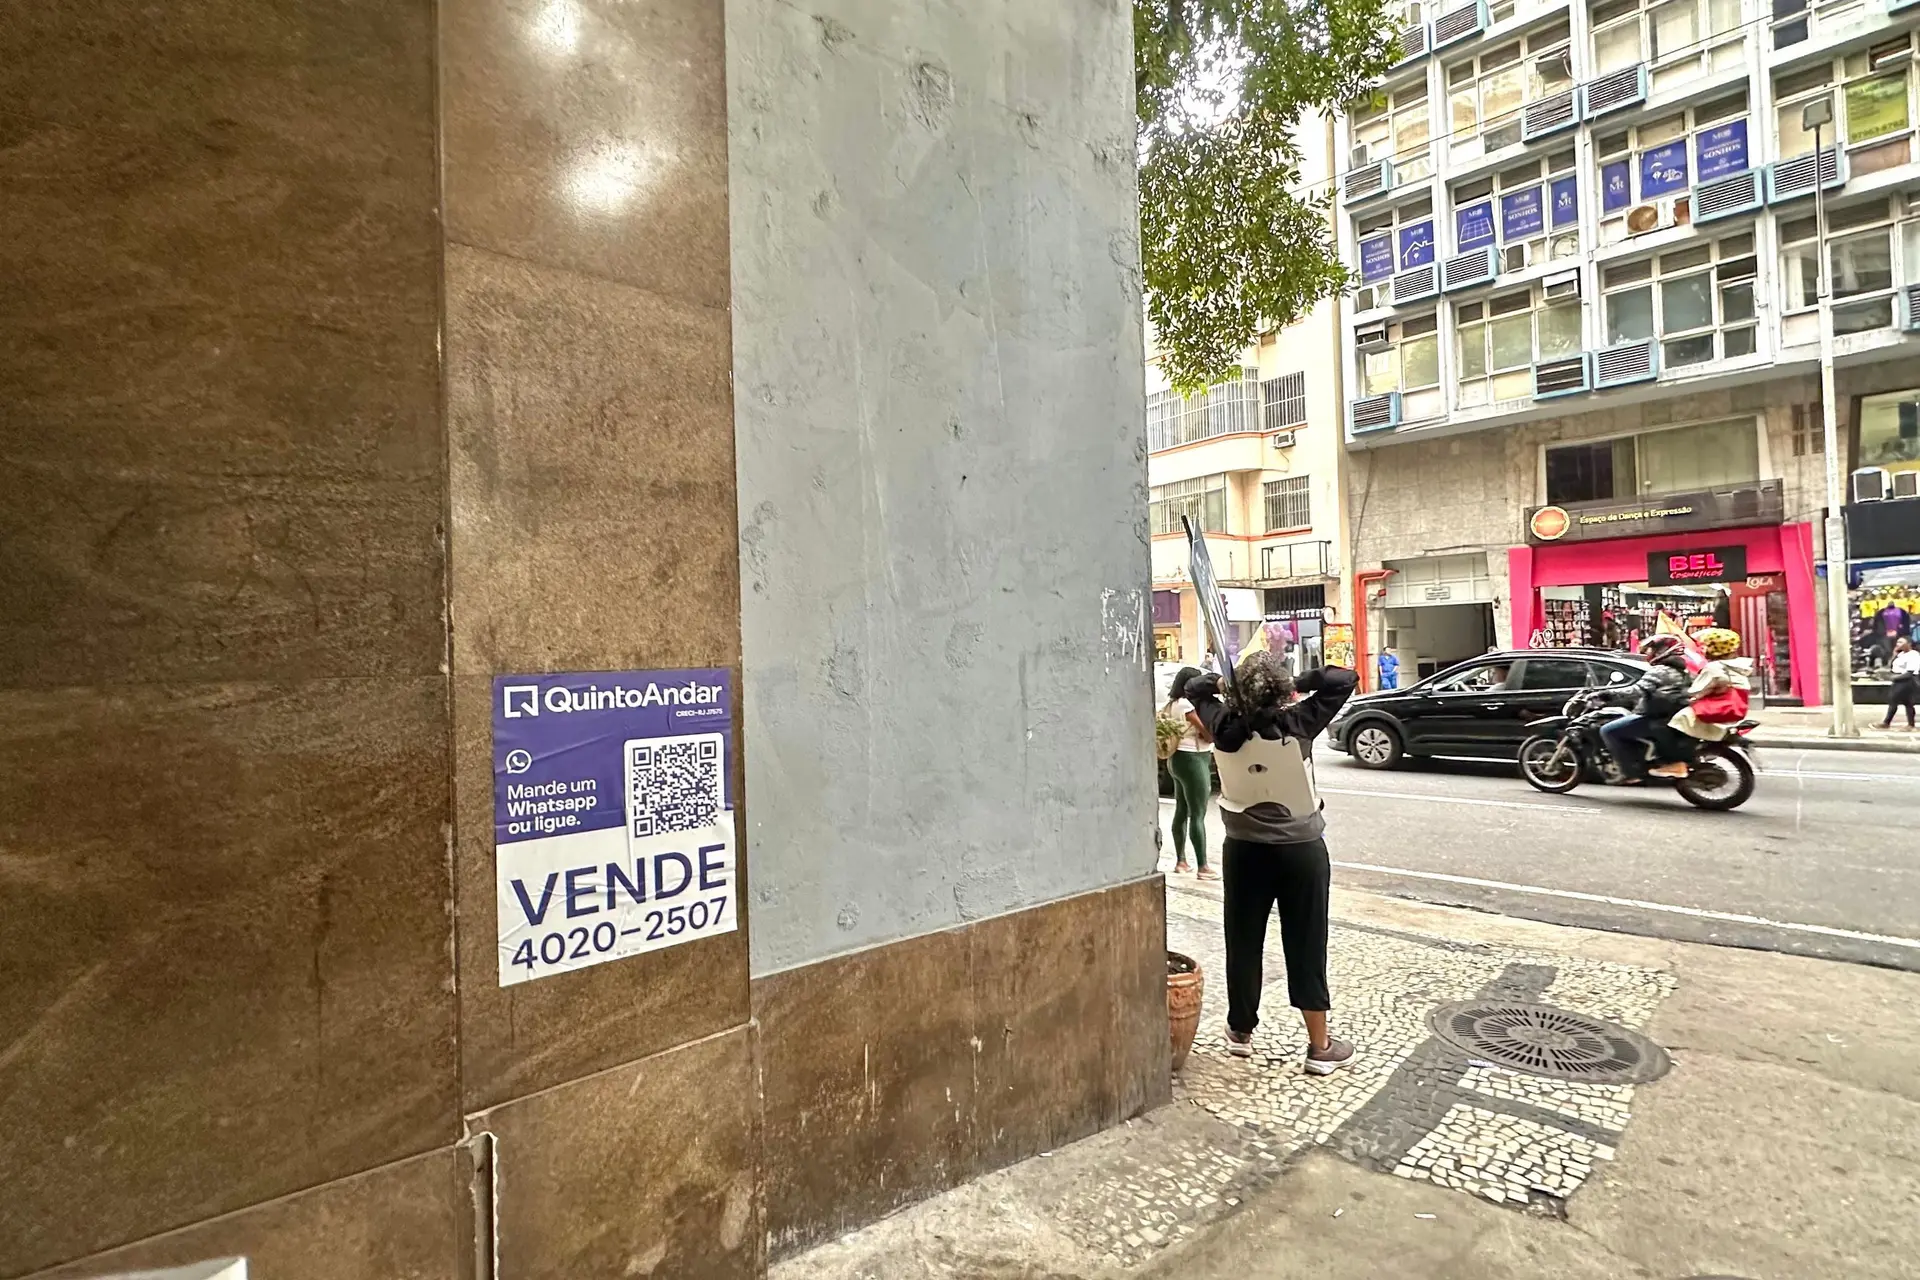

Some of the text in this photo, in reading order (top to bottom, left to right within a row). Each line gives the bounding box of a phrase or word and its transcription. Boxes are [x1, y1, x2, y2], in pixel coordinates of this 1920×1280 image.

[1579, 506, 1693, 525] Espaço de Dança e Expressão
[1669, 553, 1724, 572] BEL
[1746, 576, 1773, 589] LOLA
[544, 681, 723, 713] QuintoAndar
[507, 778, 597, 800] Mande um
[507, 793, 598, 818] Whatsapp
[507, 813, 582, 835] ou ligue.
[510, 843, 727, 927] VENDE
[511, 896, 728, 969] 4020-2507
